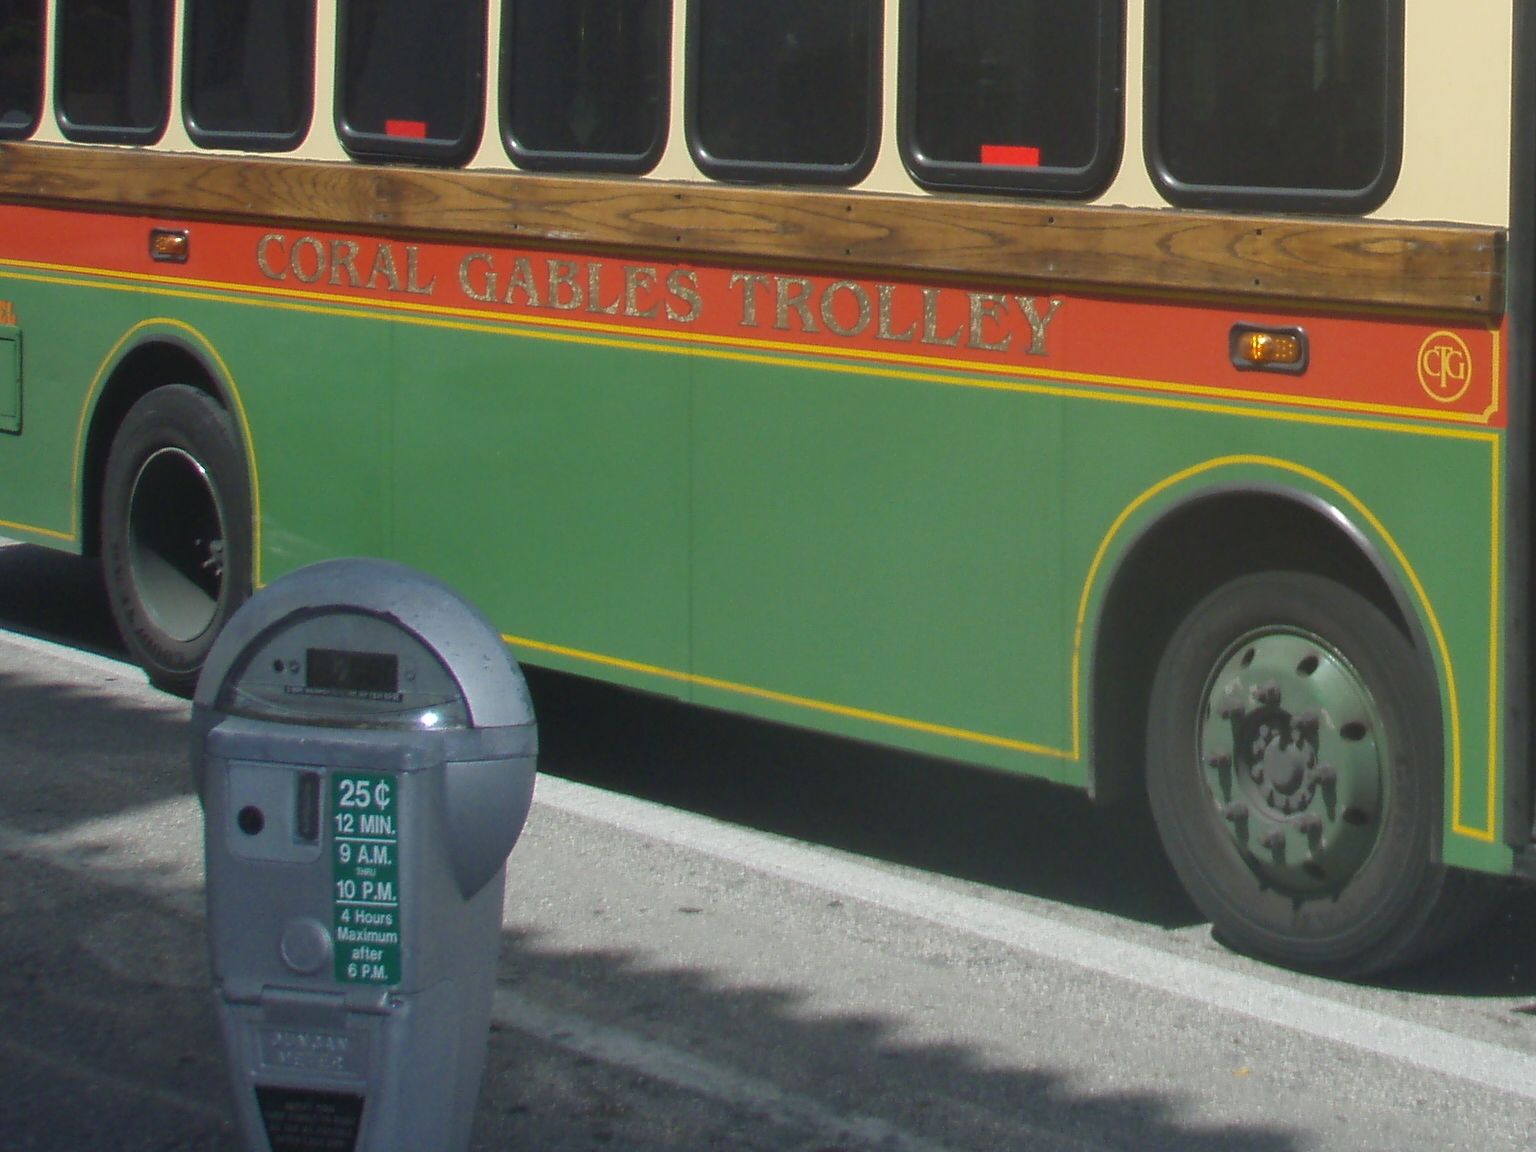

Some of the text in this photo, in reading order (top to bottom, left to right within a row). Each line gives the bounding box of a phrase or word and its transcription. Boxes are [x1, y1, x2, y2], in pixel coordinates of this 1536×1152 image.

[255, 233, 1064, 357] CORAL GABLES TROLLEY
[335, 813, 396, 835] 12 MIN.
[340, 843, 392, 865] 9 A.M.
[336, 879, 397, 901] 10 P.M.
[341, 908, 393, 926] 4 Hours
[337, 926, 398, 944] Maximum
[351, 946, 383, 960] after
[347, 962, 388, 980] 6 P.M.
